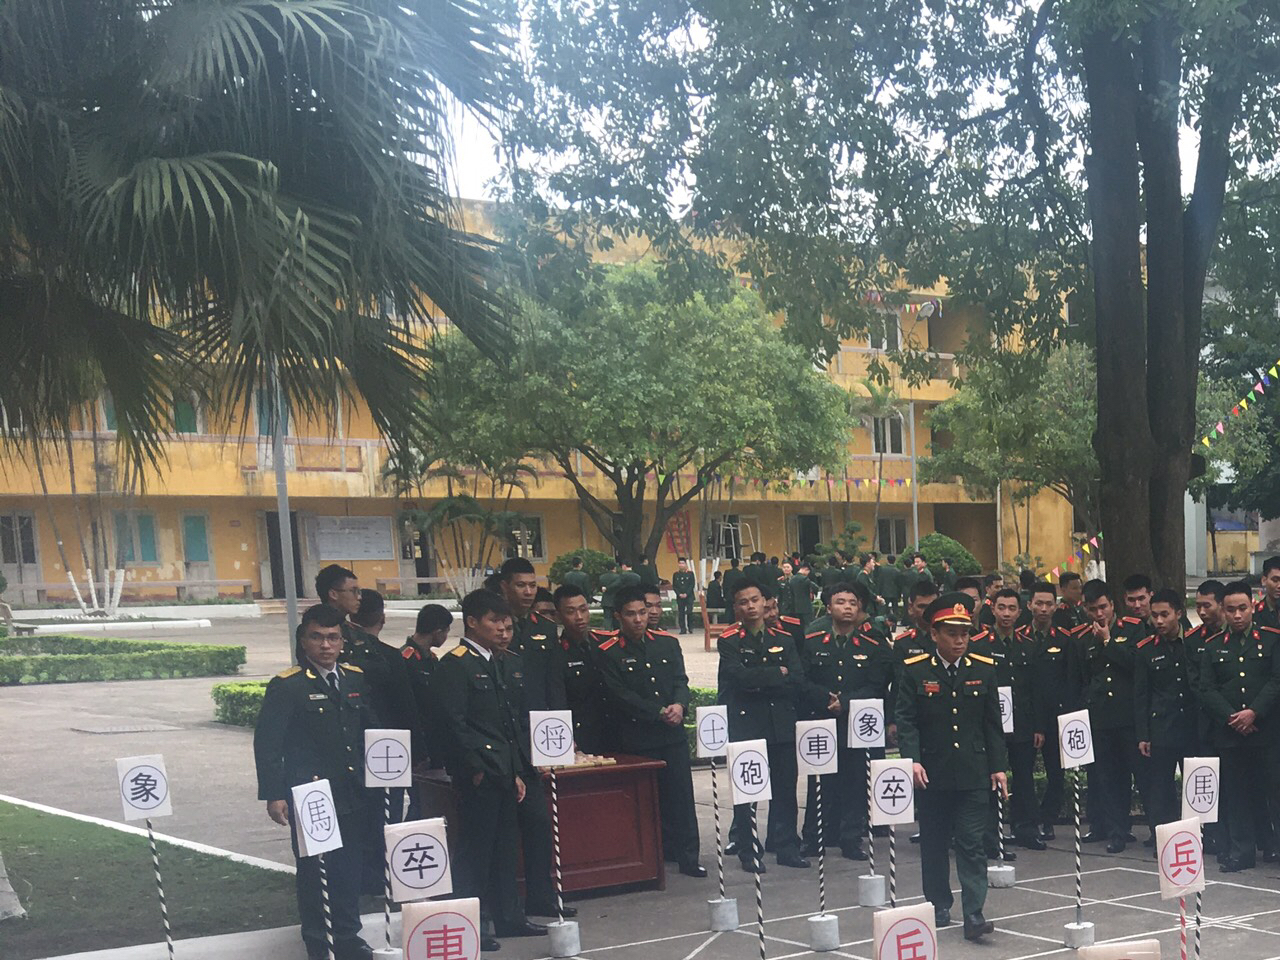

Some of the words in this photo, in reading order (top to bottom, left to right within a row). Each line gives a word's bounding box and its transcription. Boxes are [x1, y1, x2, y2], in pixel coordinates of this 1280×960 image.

[859, 713, 879, 737] 象
[1068, 728, 1086, 751] 砲
[372, 746, 403, 774] 士
[806, 734, 830, 759] 車
[131, 773, 159, 803] 象
[741, 760, 763, 787] 砲
[881, 776, 906, 807] 卒
[1192, 774, 1214, 804] 馬
[308, 798, 330, 834] 馬
[402, 843, 439, 879] 卒
[1170, 840, 1197, 878] 兵
